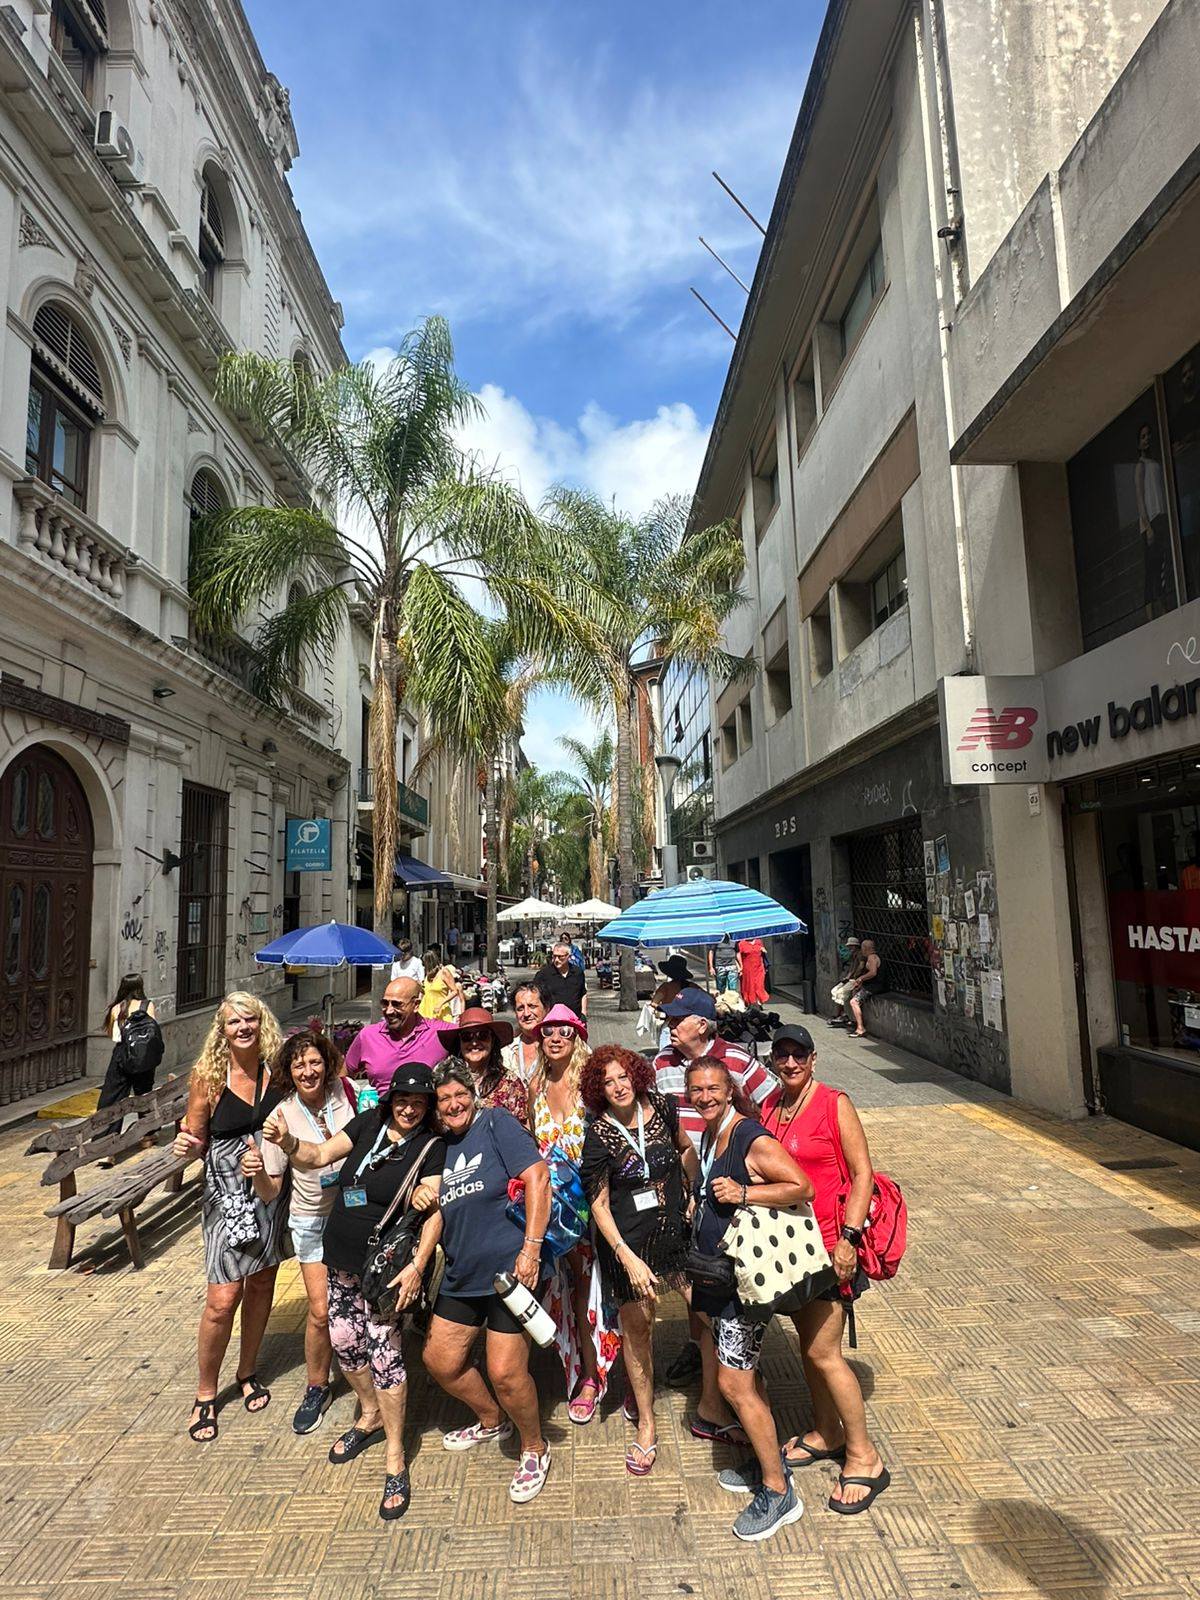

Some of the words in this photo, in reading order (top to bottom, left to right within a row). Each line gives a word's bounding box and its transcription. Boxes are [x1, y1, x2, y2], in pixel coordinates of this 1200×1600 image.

[1047, 715, 1101, 760] new
[971, 760, 1027, 773] concept
[440, 1180, 484, 1206] adidas
